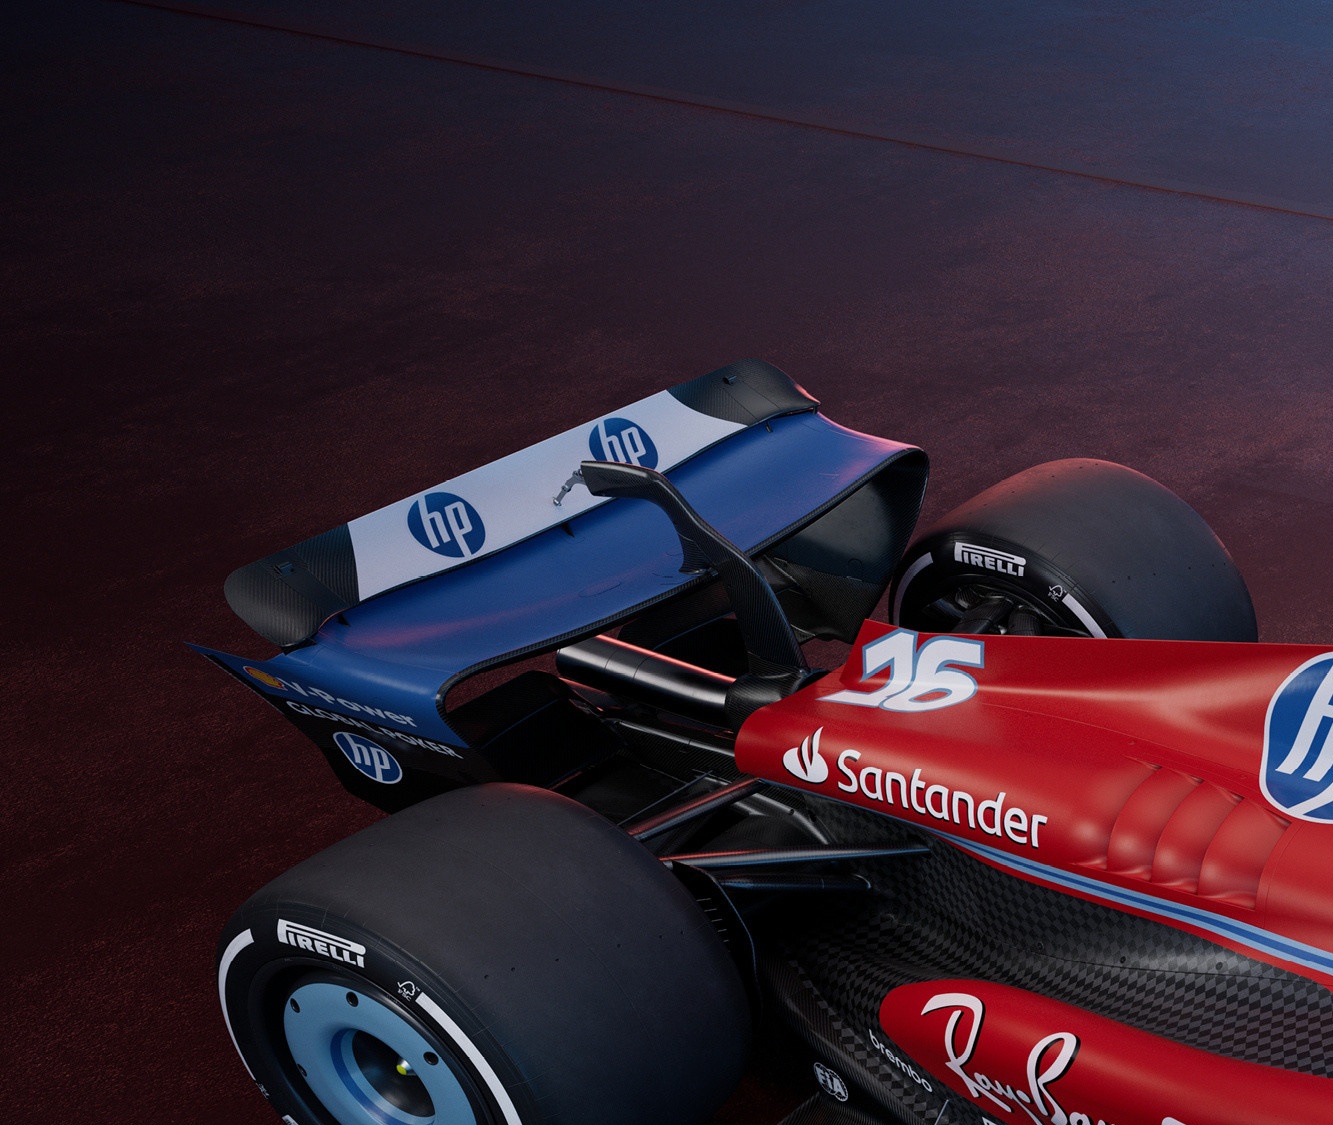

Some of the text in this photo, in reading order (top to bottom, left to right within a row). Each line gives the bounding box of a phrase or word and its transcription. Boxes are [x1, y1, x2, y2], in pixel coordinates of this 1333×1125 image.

[414, 483, 476, 558] hp
[954, 541, 1026, 577] PIRELLI
[815, 627, 985, 713] 16
[276, 676, 418, 728] V-Power
[286, 700, 381, 735] GLOBAL
[341, 732, 394, 784] hp
[836, 749, 1049, 849] Santander
[277, 918, 366, 969] PIRELLI
[868, 1029, 932, 1092] brembo
